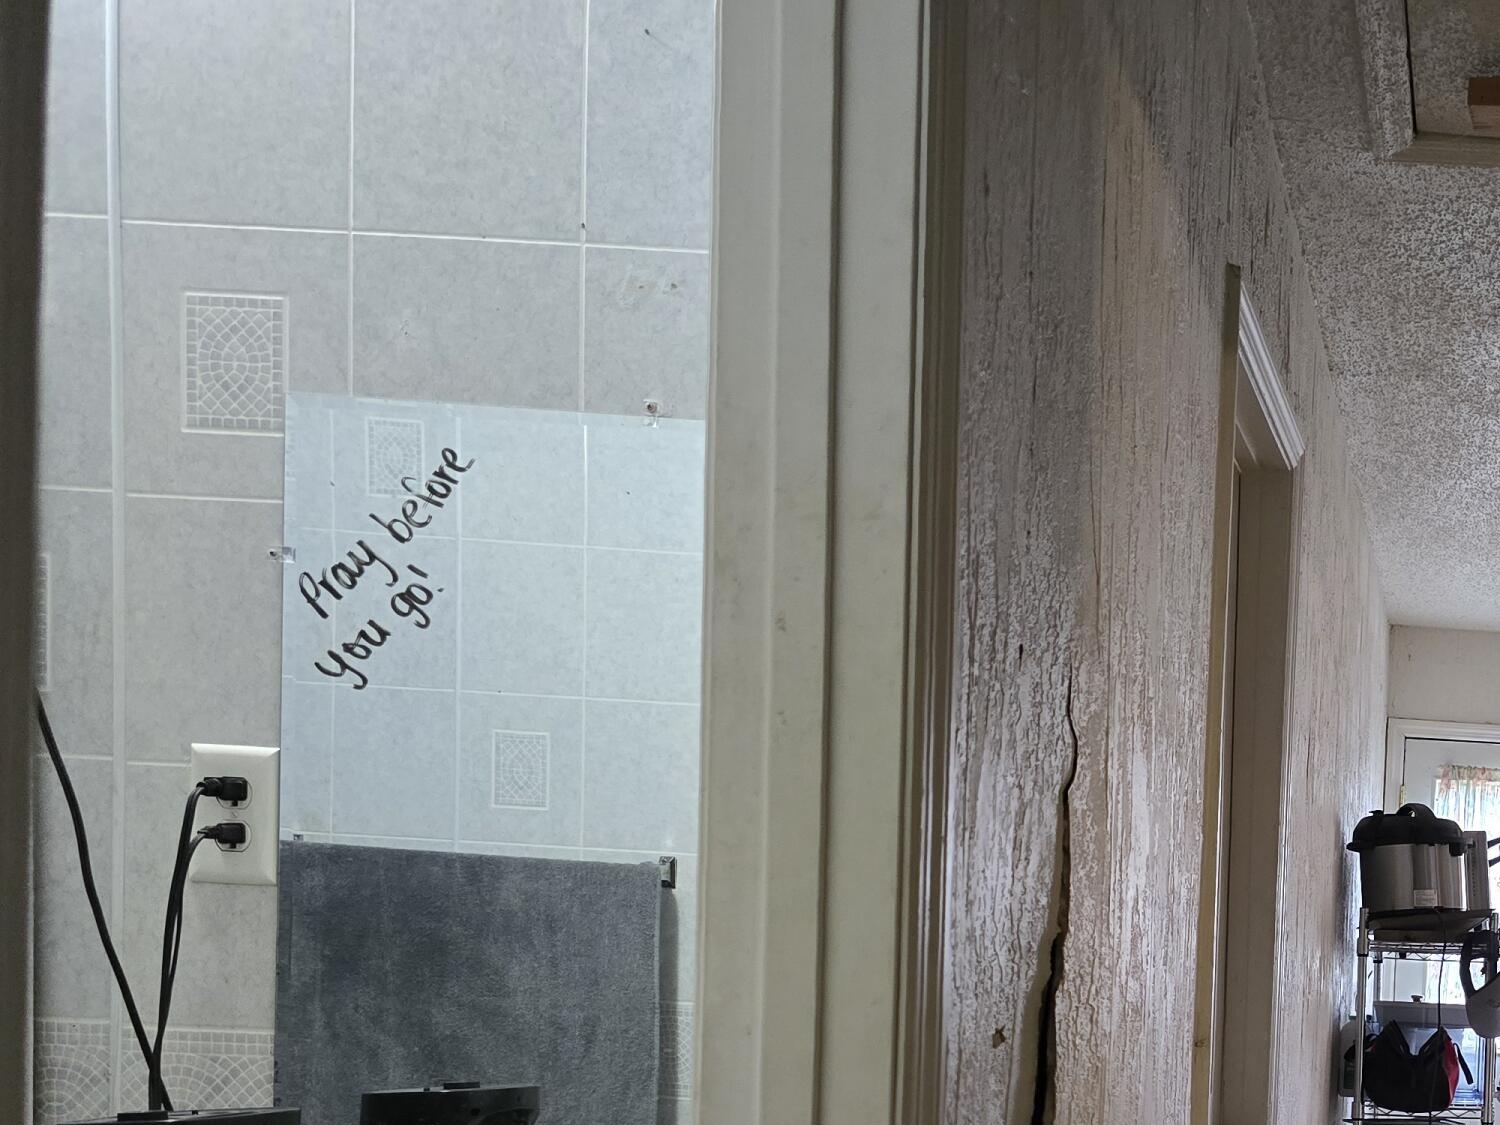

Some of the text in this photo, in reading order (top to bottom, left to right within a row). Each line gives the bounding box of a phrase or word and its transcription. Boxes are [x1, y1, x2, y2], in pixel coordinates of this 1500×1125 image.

[299, 448, 475, 619] Pray before
[391, 564, 444, 629] go!
